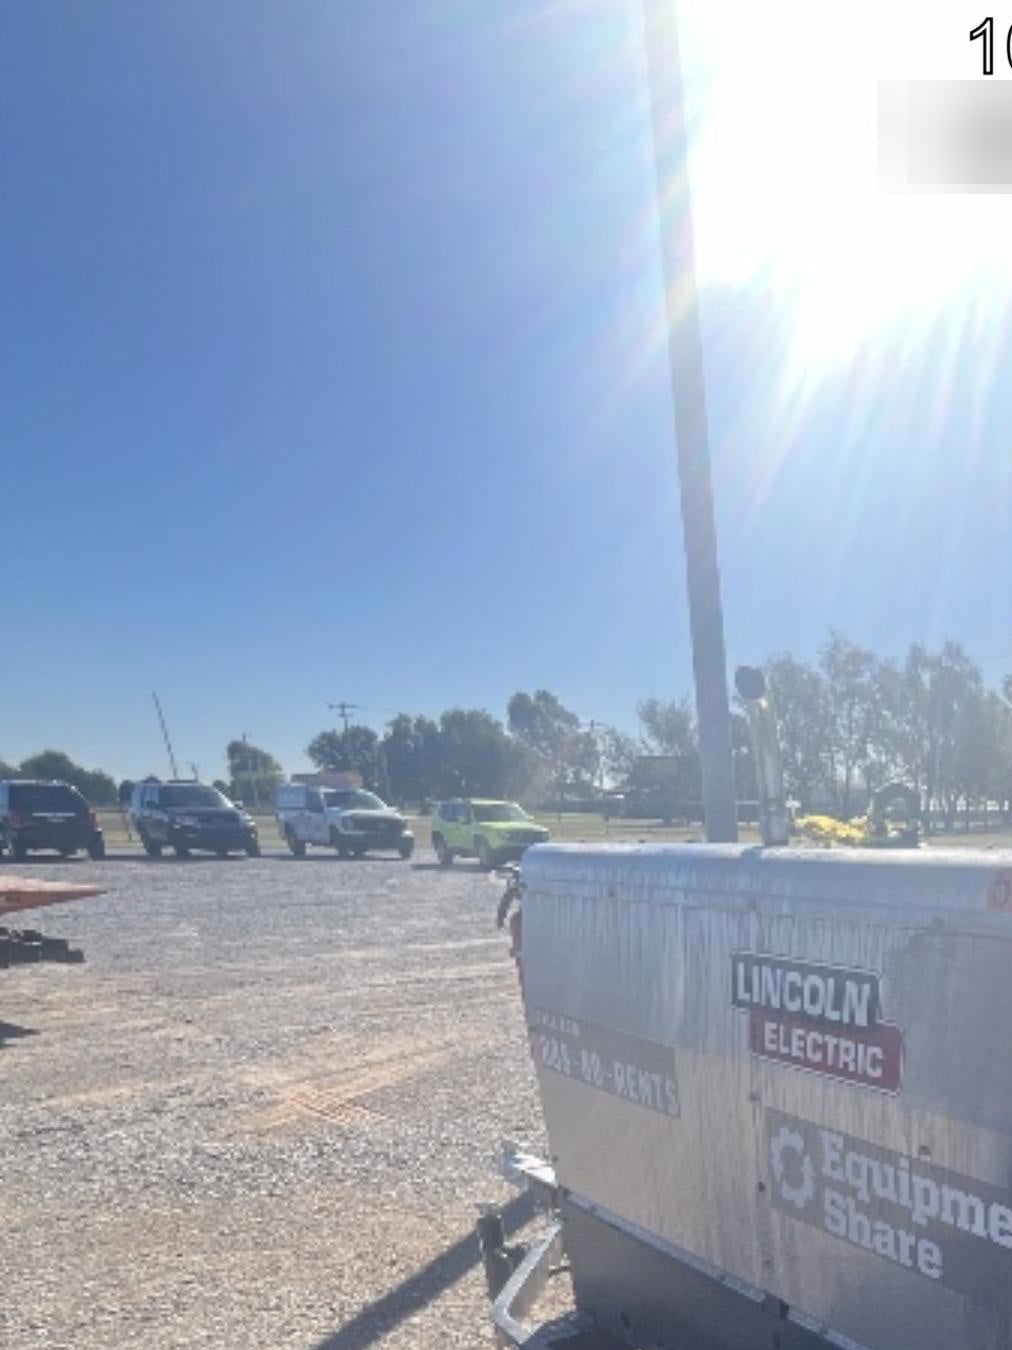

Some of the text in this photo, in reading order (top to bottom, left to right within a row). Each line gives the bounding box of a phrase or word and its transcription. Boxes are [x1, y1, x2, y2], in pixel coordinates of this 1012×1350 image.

[737, 962, 871, 1027] LINCOLN
[764, 1021, 883, 1078] ELECTRIC
[824, 1186, 944, 1280] Share
